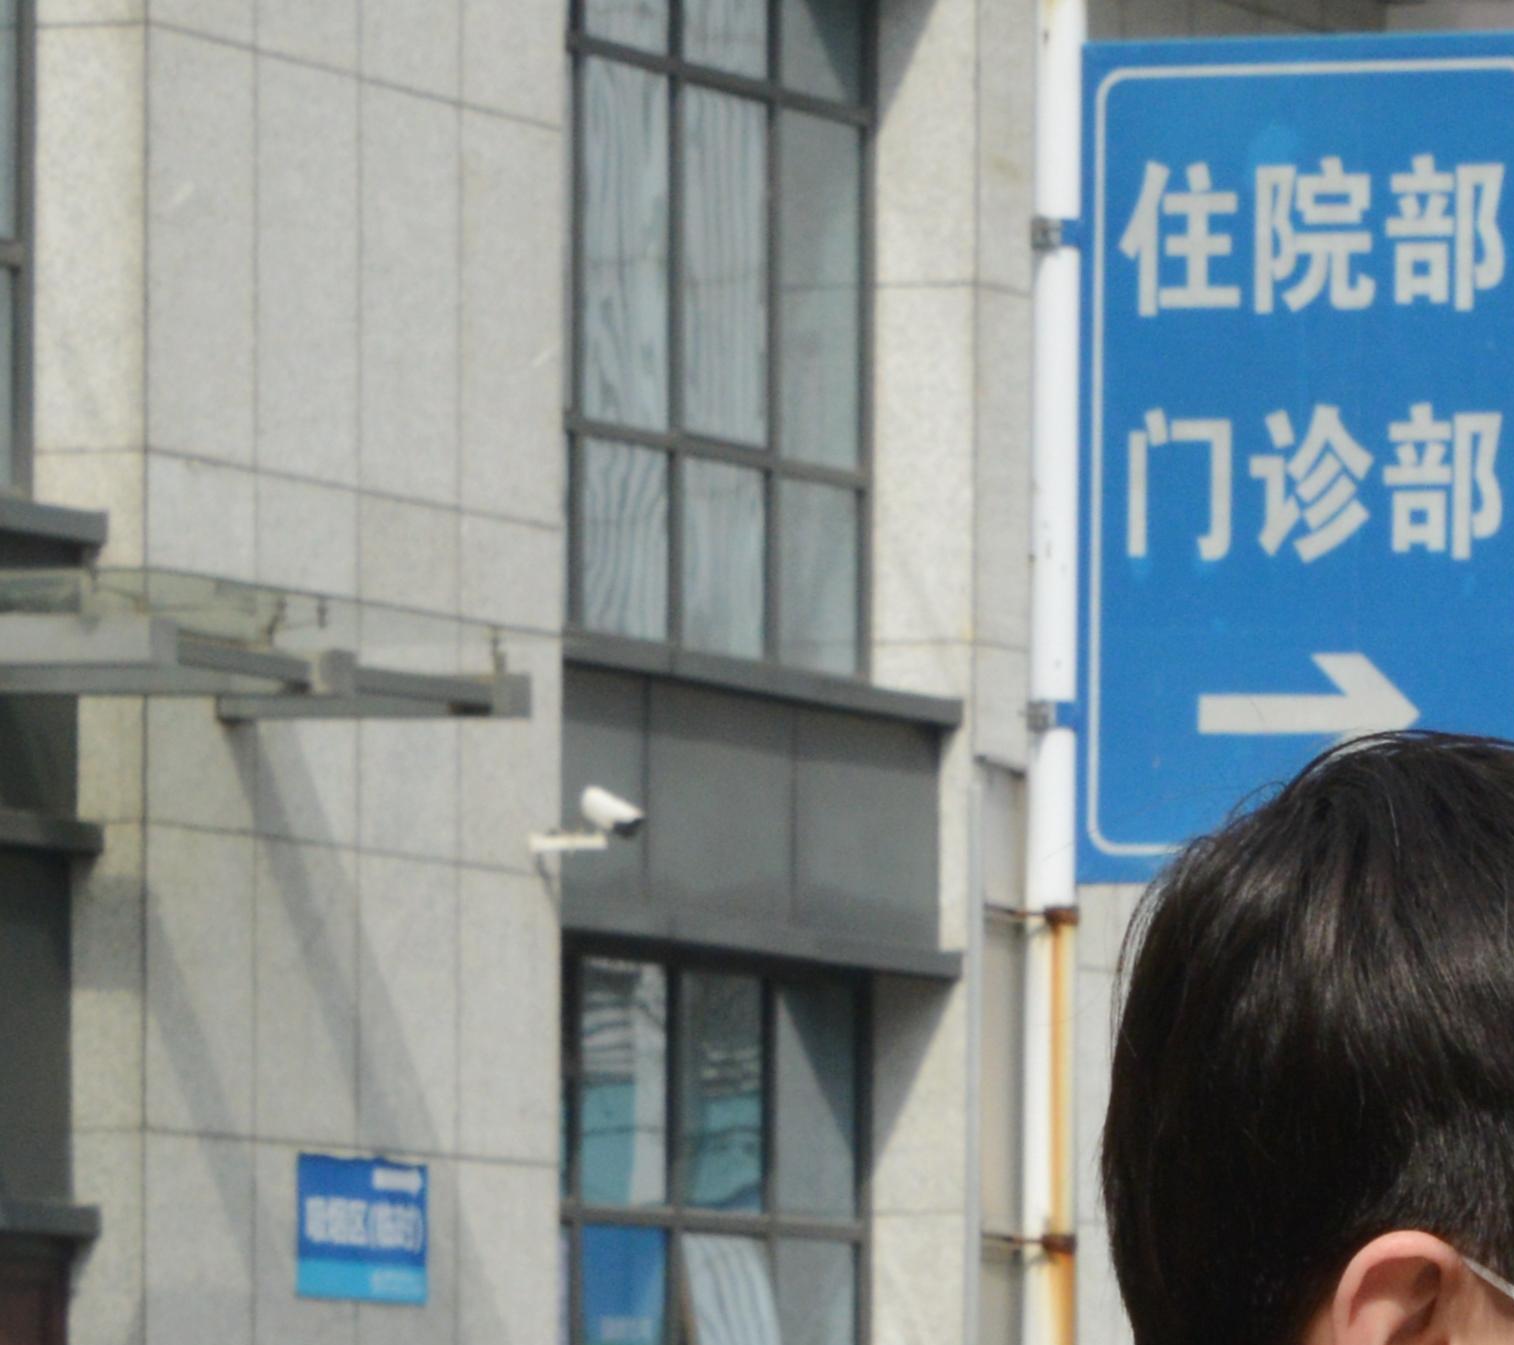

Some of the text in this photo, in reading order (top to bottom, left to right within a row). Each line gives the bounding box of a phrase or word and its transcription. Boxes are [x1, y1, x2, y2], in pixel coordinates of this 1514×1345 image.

[1120, 154, 1507, 316] 住院部
[1125, 403, 1504, 565] 门诊部
